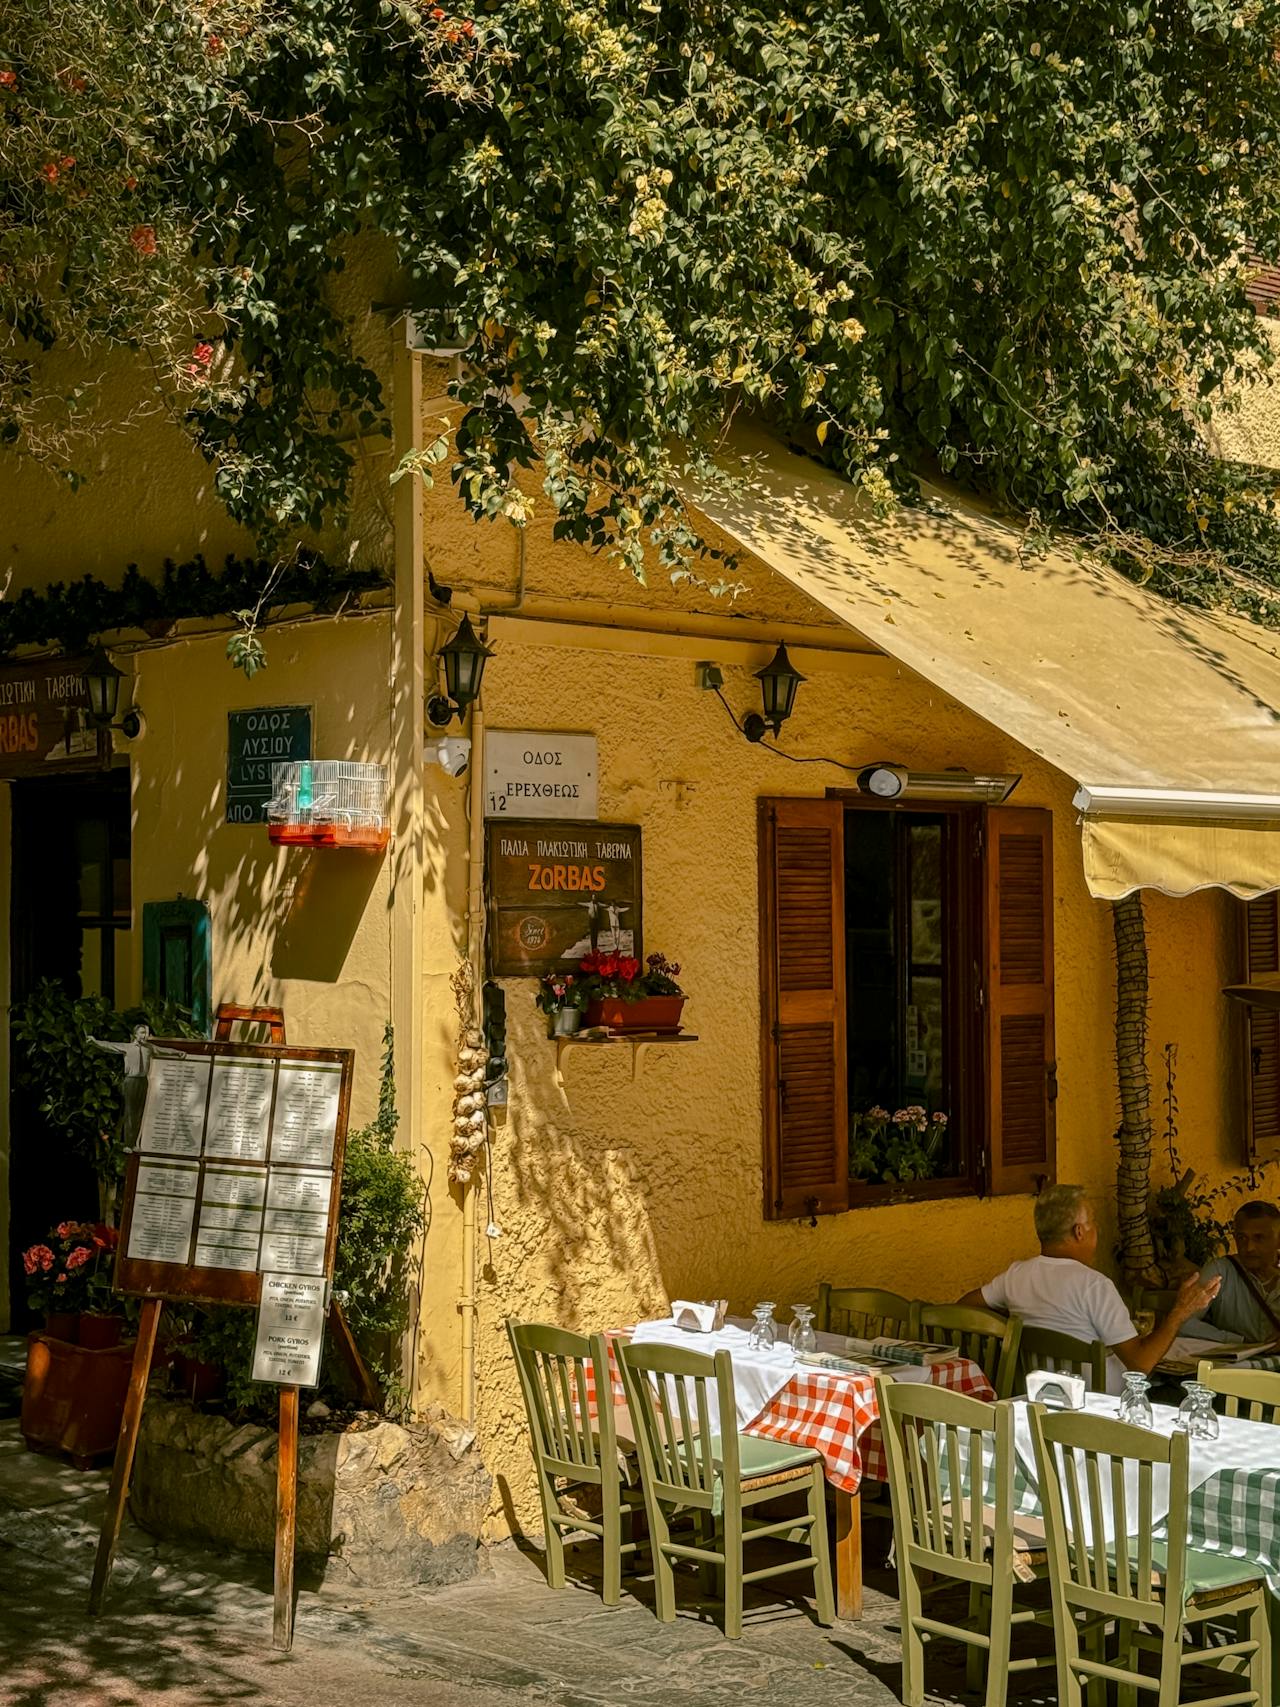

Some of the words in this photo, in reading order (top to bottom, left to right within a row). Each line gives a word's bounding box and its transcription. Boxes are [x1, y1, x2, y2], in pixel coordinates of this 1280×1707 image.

[0, 680, 36, 705] ΙΩΤΙΚΗ
[45, 674, 86, 700] ΤΑΒΕΡΝ
[247, 713, 291, 732] ΟΔΟΣ
[242, 736, 294, 756] ΛΥΣΙΟΥ
[523, 751, 562, 765] ΟΔΟΣ
[241, 763, 279, 780] LYSI
[506, 782, 579, 798] ΕΡΕΧΘΕΩΣ
[490, 795, 507, 811] 12
[500, 839, 529, 857] ΠΑΛΙΑ
[537, 840, 588, 858] ΠΛΑΚΙΩΤΙΚΗ
[595, 842, 632, 859] ΤΑΒΕΡΝΑ
[528, 864, 607, 891] ZORBAS
[268, 1281, 297, 1290] CHICKEN
[299, 1283, 321, 1292] GYROS
